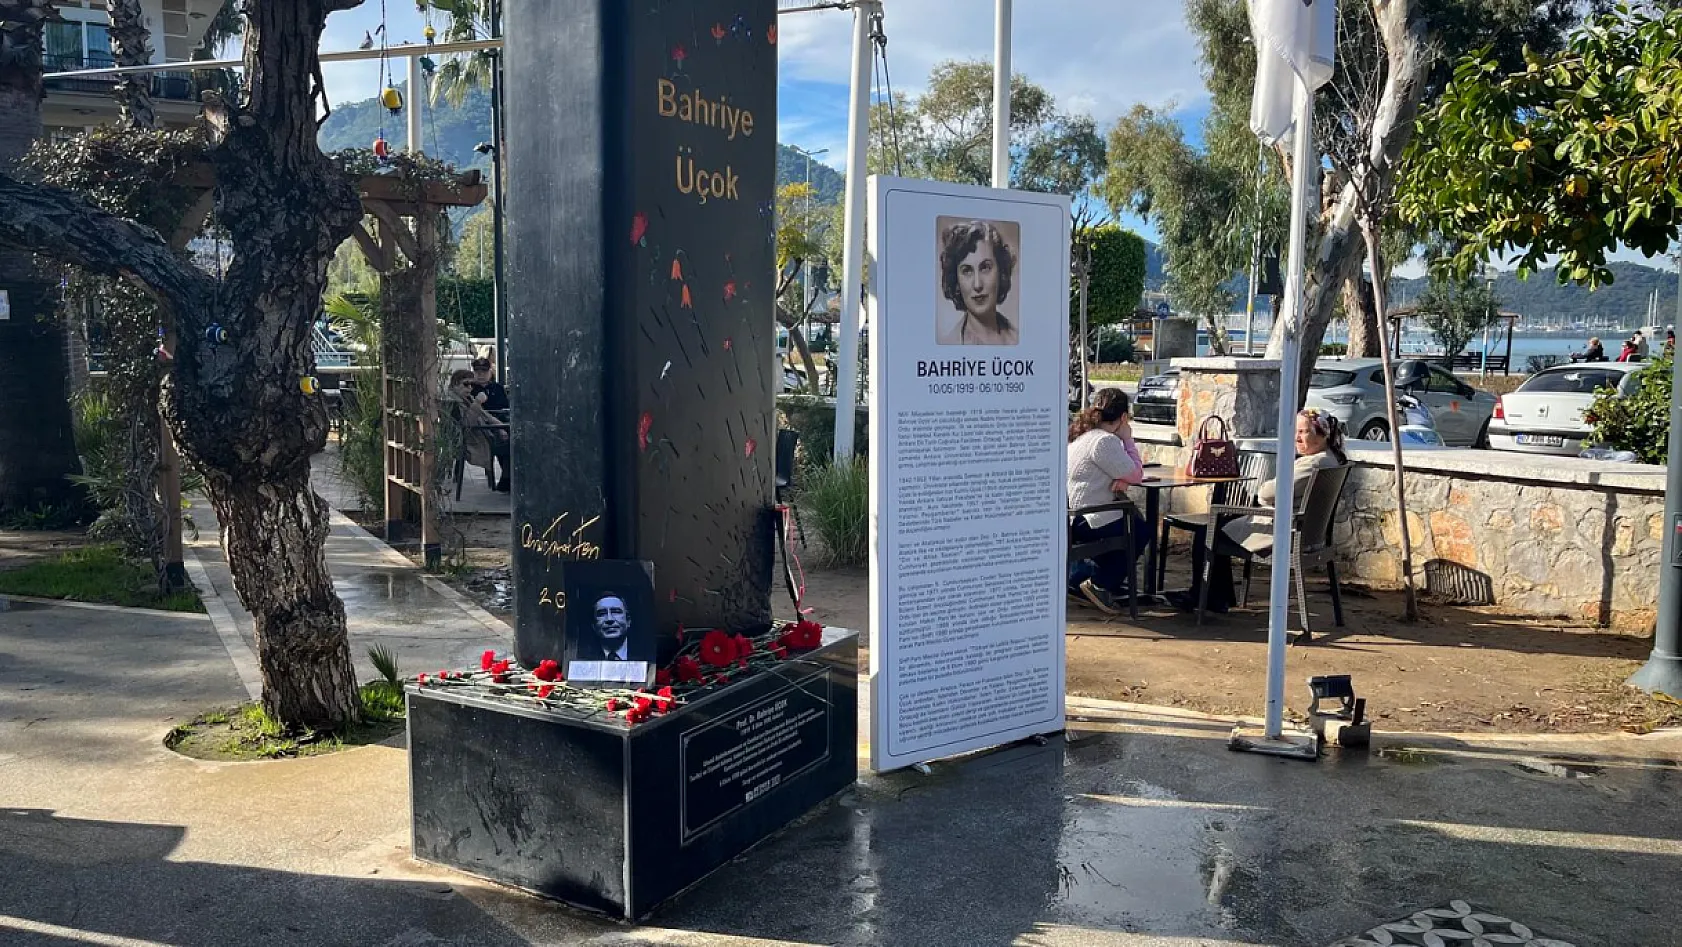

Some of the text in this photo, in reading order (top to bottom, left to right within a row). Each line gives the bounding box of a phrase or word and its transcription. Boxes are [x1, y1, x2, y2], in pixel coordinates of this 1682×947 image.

[658, 78, 754, 141] Bahriye
[676, 145, 739, 205] Üçok
[917, 357, 1034, 380] BAHRİYE ÜÇOK
